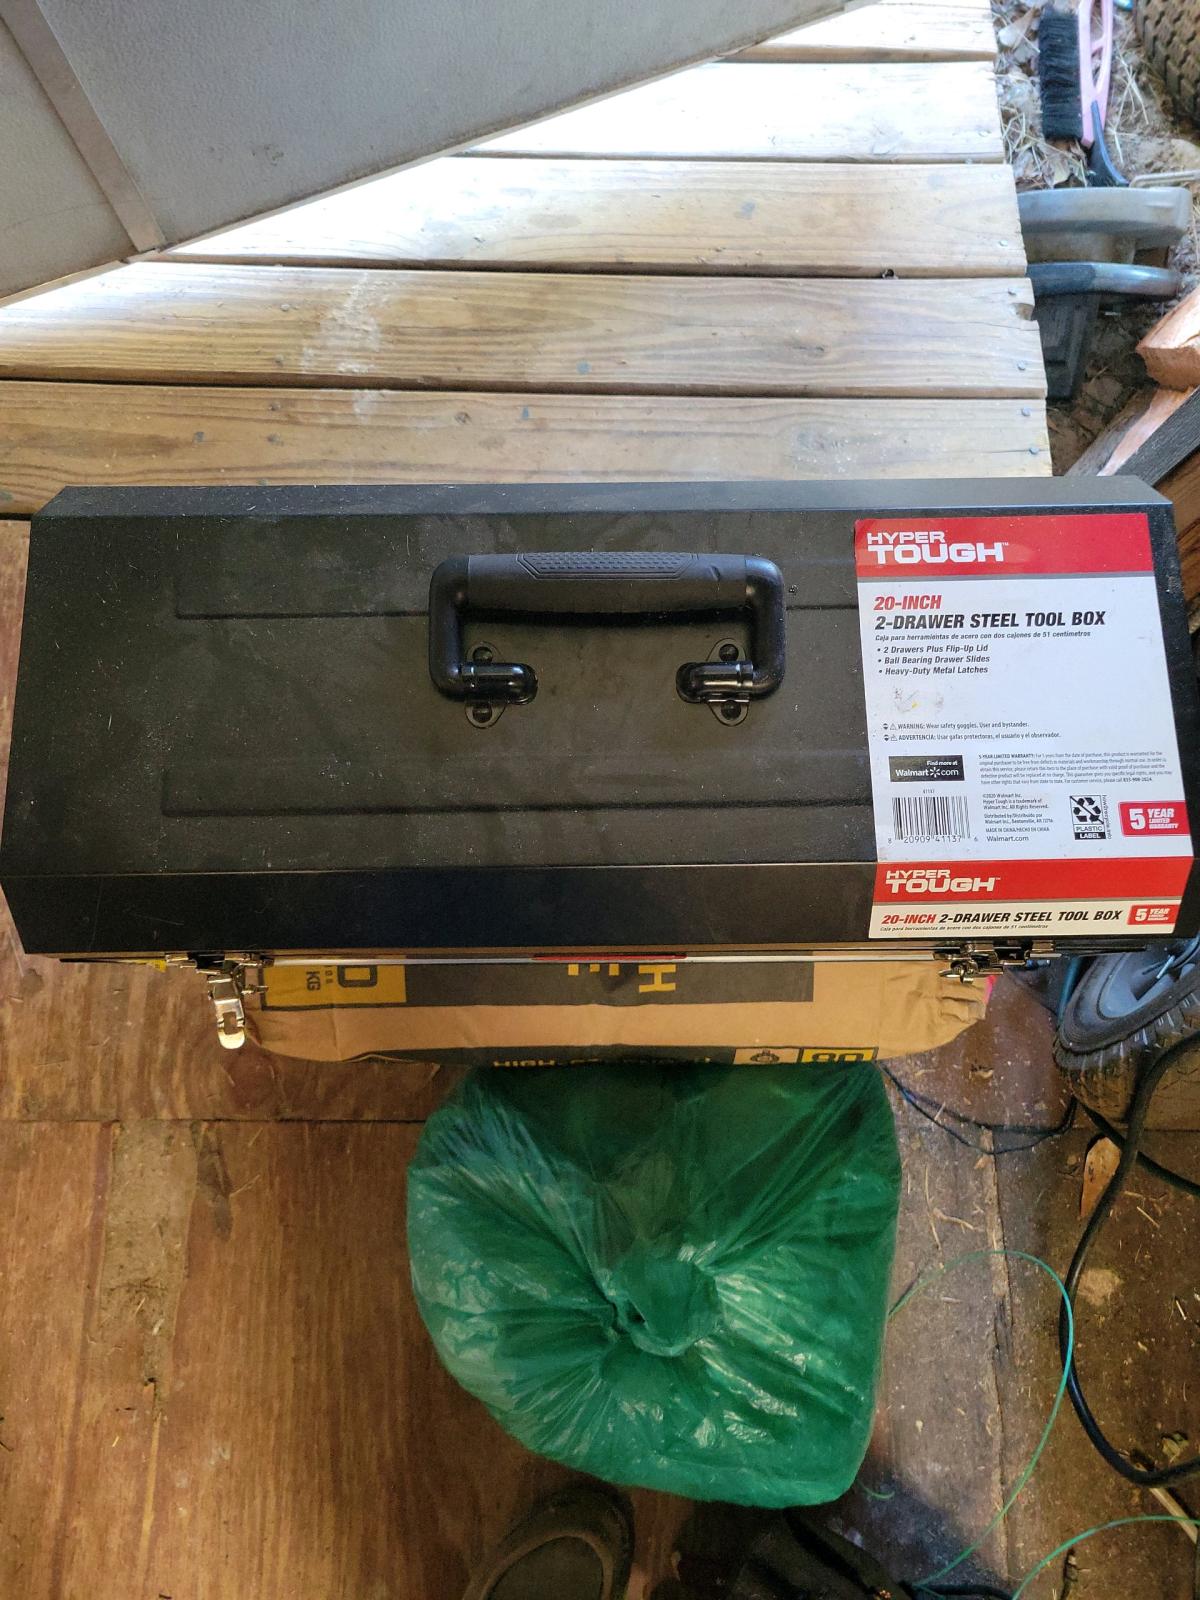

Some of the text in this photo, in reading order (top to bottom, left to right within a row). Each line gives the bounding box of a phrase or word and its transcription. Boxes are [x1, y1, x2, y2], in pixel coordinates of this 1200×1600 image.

[866, 531, 946, 544] HYPER
[868, 542, 1004, 565] TOUGH
[874, 594, 942, 611] 20-INCH
[875, 611, 1107, 630] 2-DRAWER STEEL TOOL BOX
[906, 633, 950, 641] herramientas
[1006, 632, 1031, 640] cajones
[883, 644, 989, 654] 2 Drawers Plus Flip-Up Lid
[884, 655, 990, 665] Ball Bearing Drawer Slides
[885, 665, 988, 676] Heavy-Duty Metal Latches
[940, 722, 956, 730] safety
[957, 722, 978, 730] goggles.
[964, 733, 995, 741] protectoras,
[895, 768, 929, 777] Walmart
[1128, 808, 1175, 830] 5 YEAR
[1075, 824, 1103, 832] PLASTIC
[903, 835, 931, 844] 20909
[935, 835, 962, 843] 41137
[886, 869, 951, 879] HYPER
[885, 877, 996, 894] TOUGH
[881, 910, 1123, 925] 20-INCH 2-DRAWER STEEL TOOL BOX
[1134, 908, 1148, 922] 5
[306, 971, 321, 991] KG
